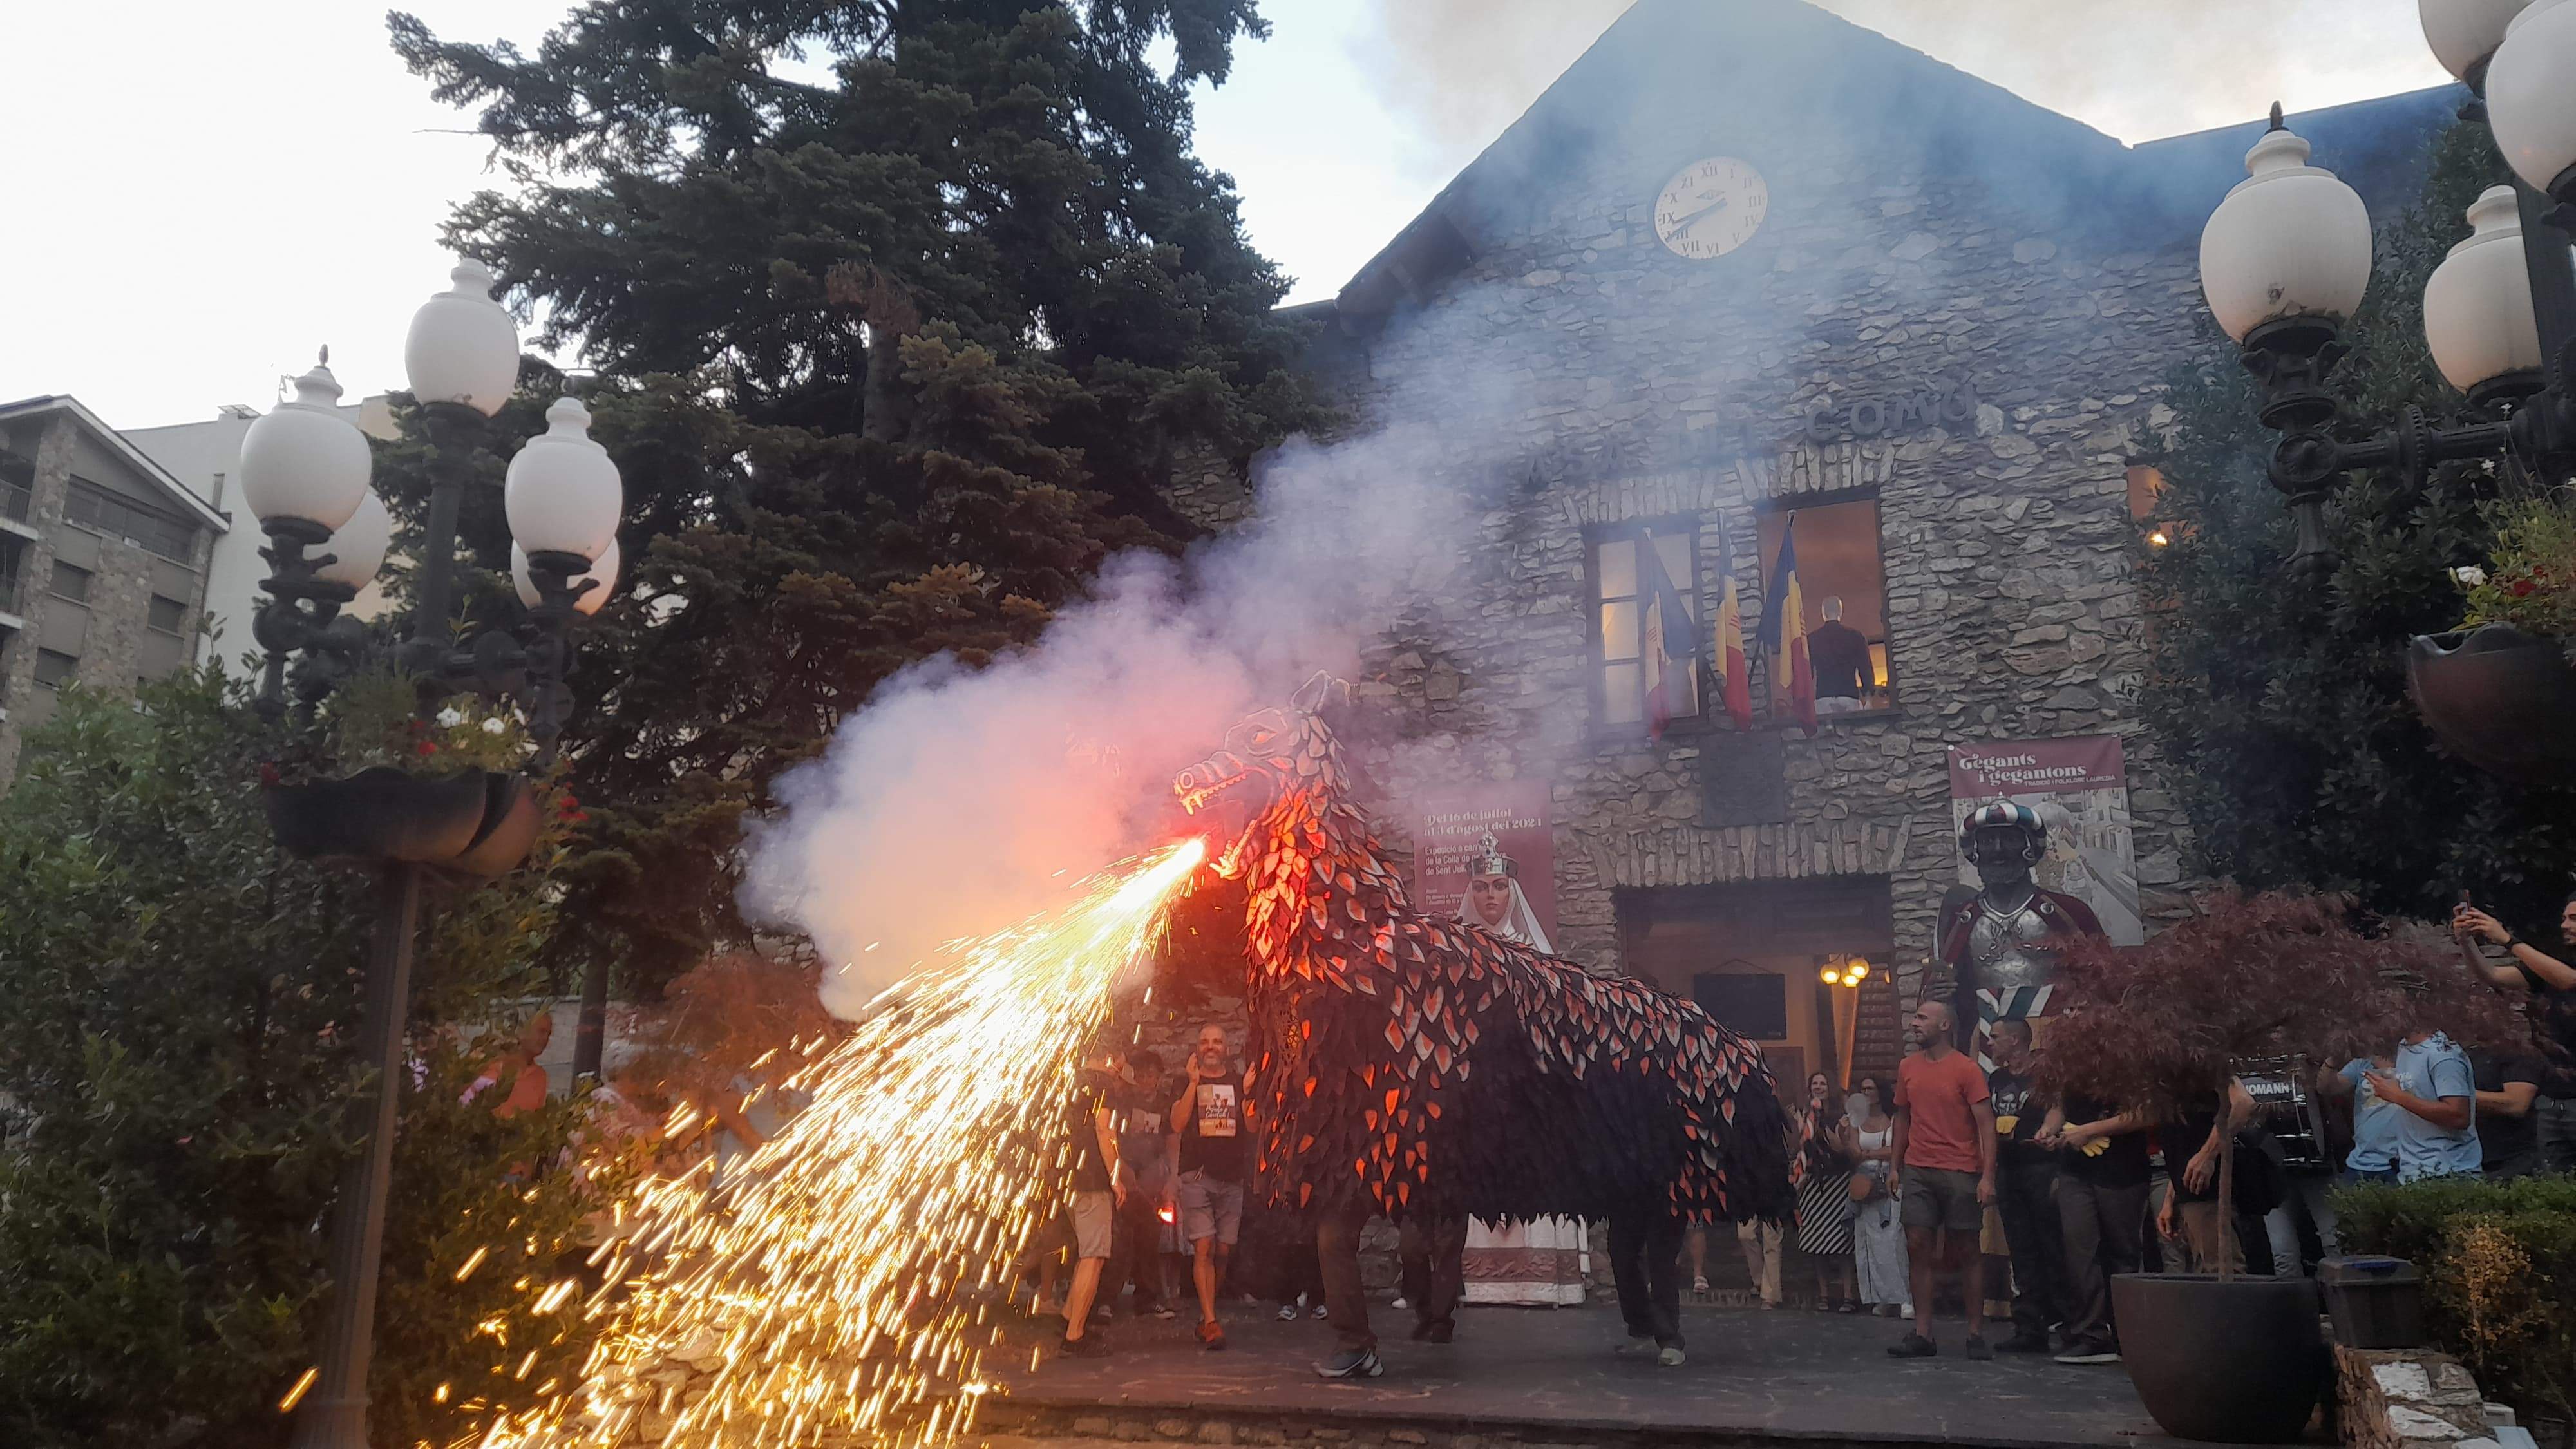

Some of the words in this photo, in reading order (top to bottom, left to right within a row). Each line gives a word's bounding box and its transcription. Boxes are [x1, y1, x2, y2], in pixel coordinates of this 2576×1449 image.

[1702, 165, 1718, 177] XII
[1681, 176, 1693, 189] XI
[1670, 192, 1678, 204] X
[1748, 195, 1761, 207] III
[1662, 211, 1676, 225] IX
[1732, 232, 1740, 244] V
[1682, 240, 1700, 253] VII
[1707, 242, 1719, 255] VI
[1959, 752, 2036, 773] Gegants
[1978, 770, 1985, 783] i
[1989, 765, 2087, 786] gegantons
[1423, 814, 1447, 826] Del
[1463, 811, 1477, 820] de
[1480, 808, 1511, 820] juliol
[1492, 820, 1510, 831] del
[1425, 844, 1456, 856] Exposició
[1443, 855, 1459, 864] Colla
[1461, 854, 1470, 862] de
[1435, 866, 1451, 875] Sant
